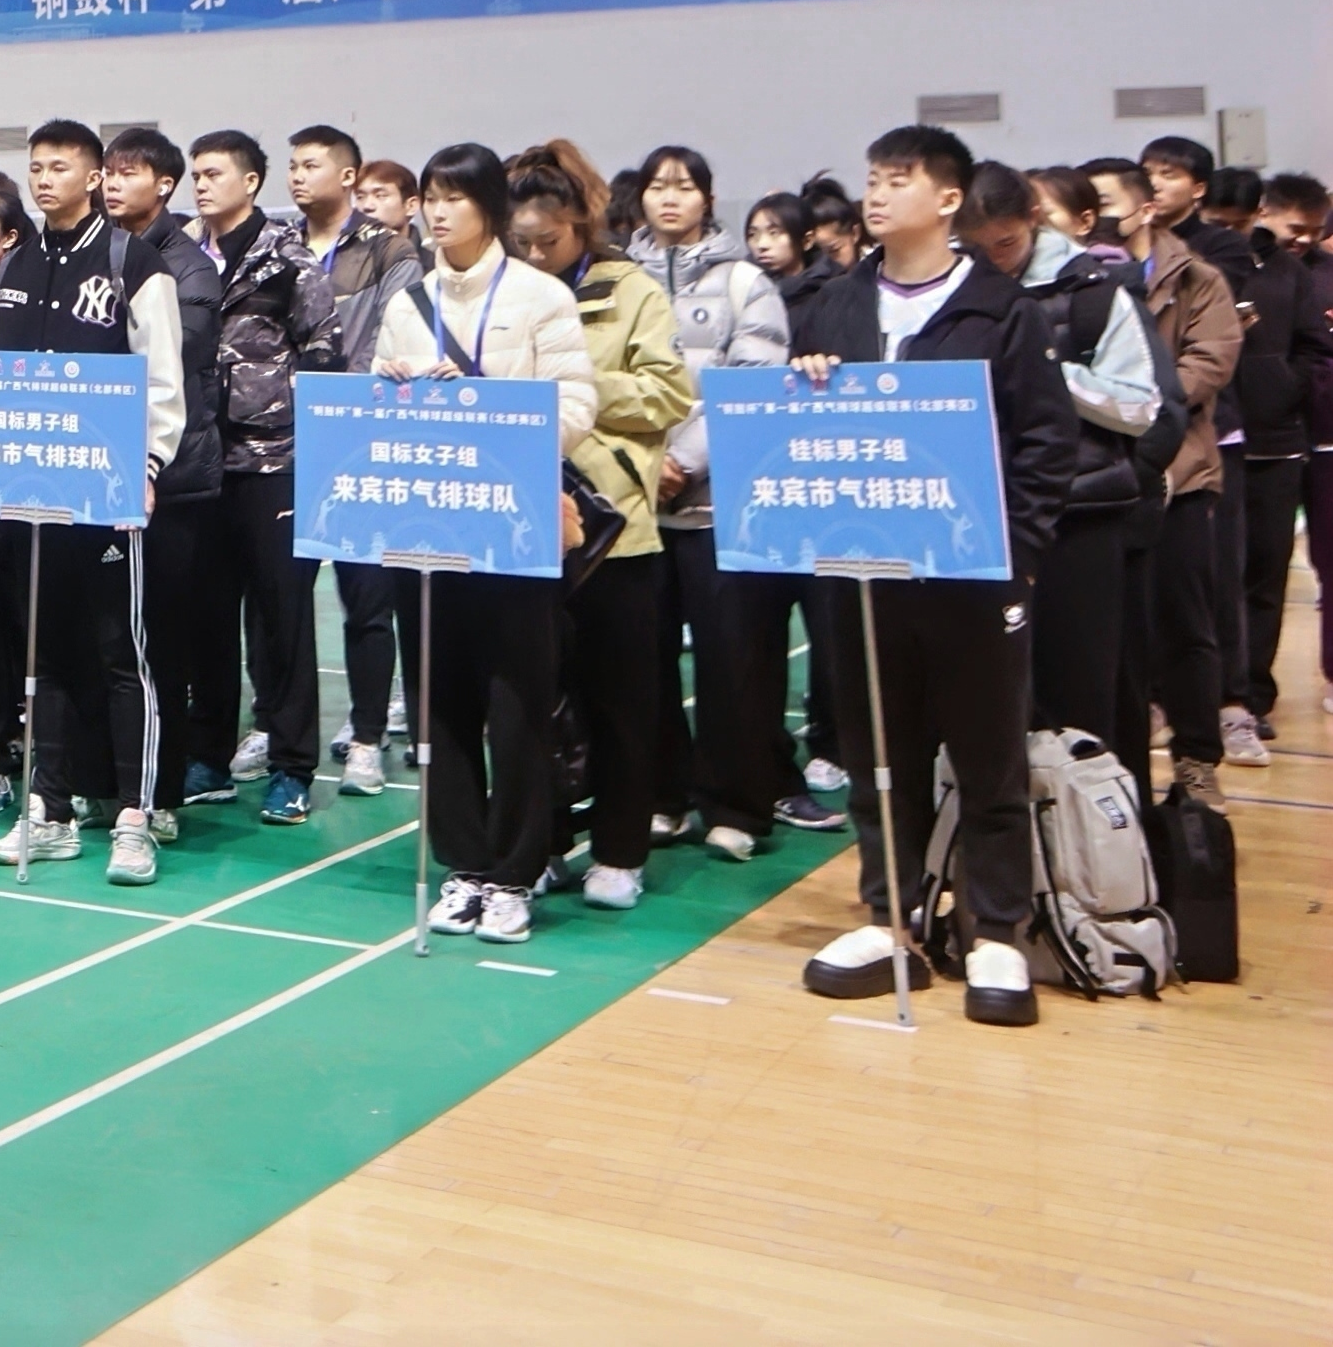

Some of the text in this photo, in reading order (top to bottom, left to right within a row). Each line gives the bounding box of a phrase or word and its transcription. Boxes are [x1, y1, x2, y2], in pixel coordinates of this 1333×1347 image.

[370, 442, 478, 468] 国标女子组
[788, 438, 908, 463] 桂标男子组
[333, 473, 519, 514] 来宾市气排球队
[752, 476, 957, 510] 来宾市气排球队
